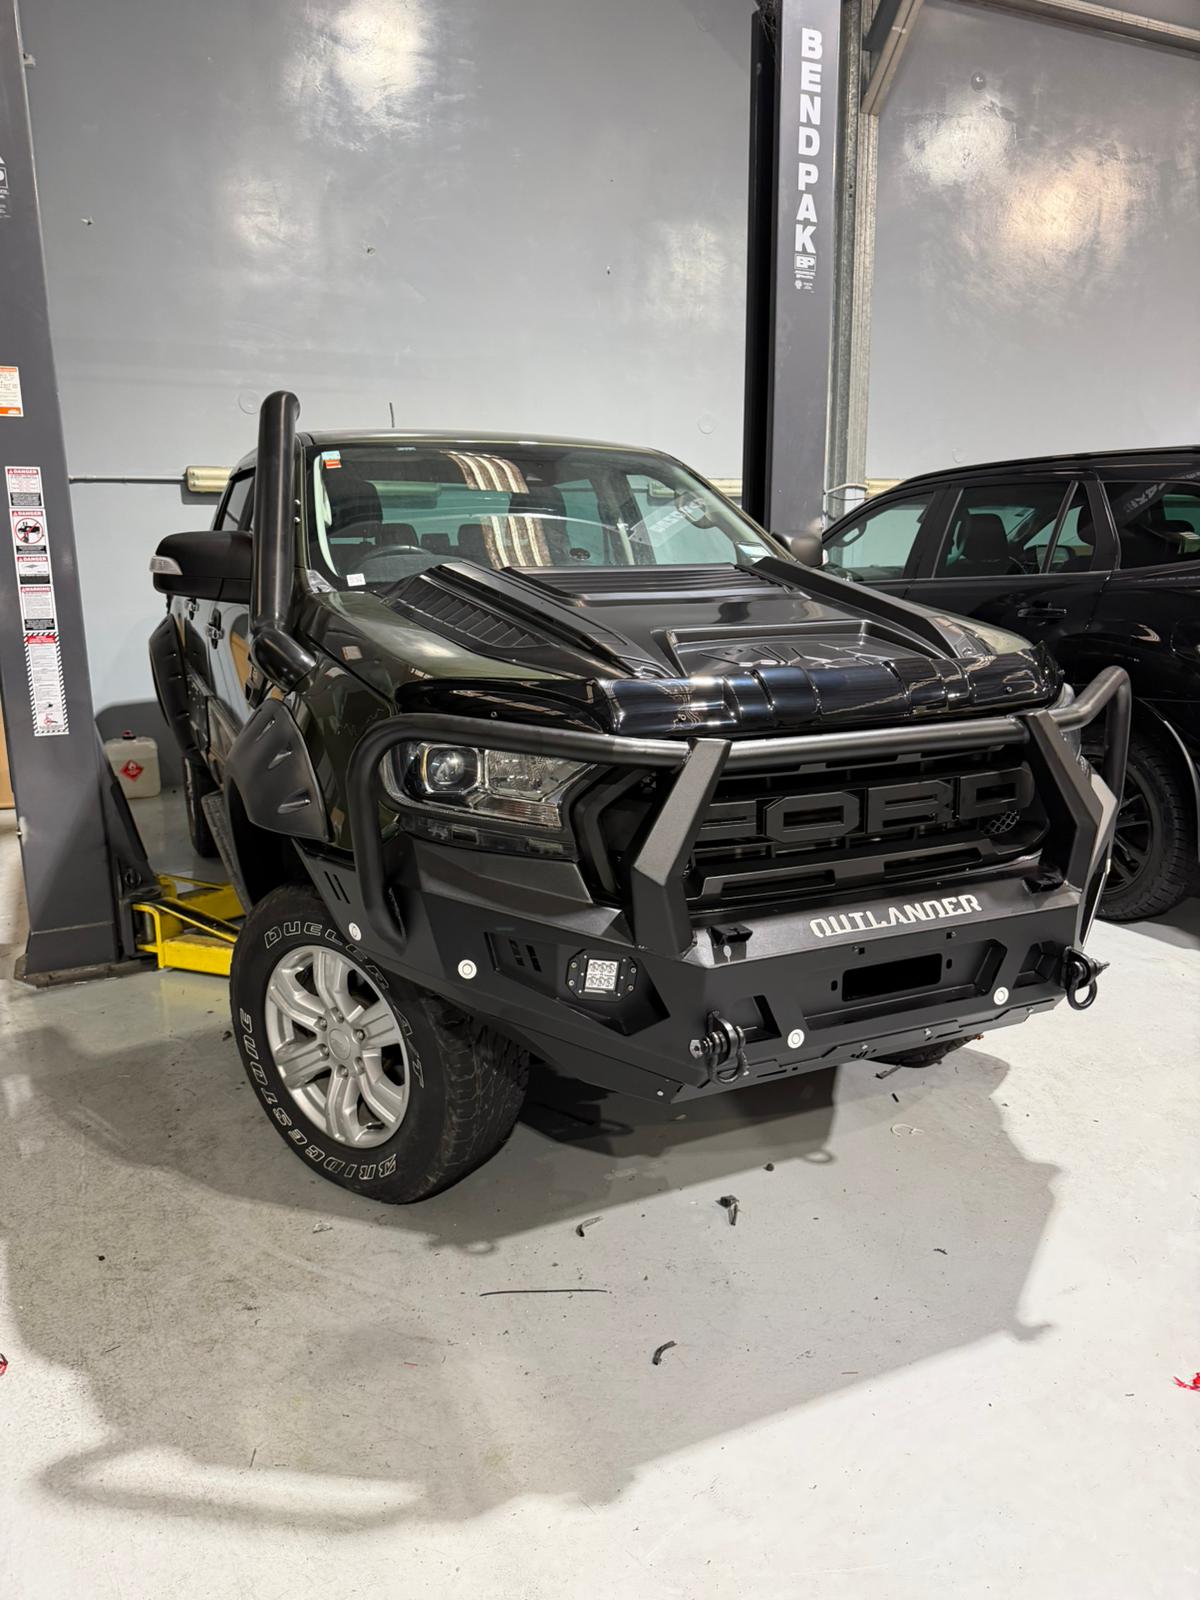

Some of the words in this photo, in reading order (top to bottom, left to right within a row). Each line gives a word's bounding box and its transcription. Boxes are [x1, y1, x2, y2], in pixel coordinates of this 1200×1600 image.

[795, 27, 823, 254] BENDPAK
[796, 255, 815, 269] BP
[809, 894, 983, 938] OUTLANDER
[239, 1007, 397, 1181] BRIDGESTONE
